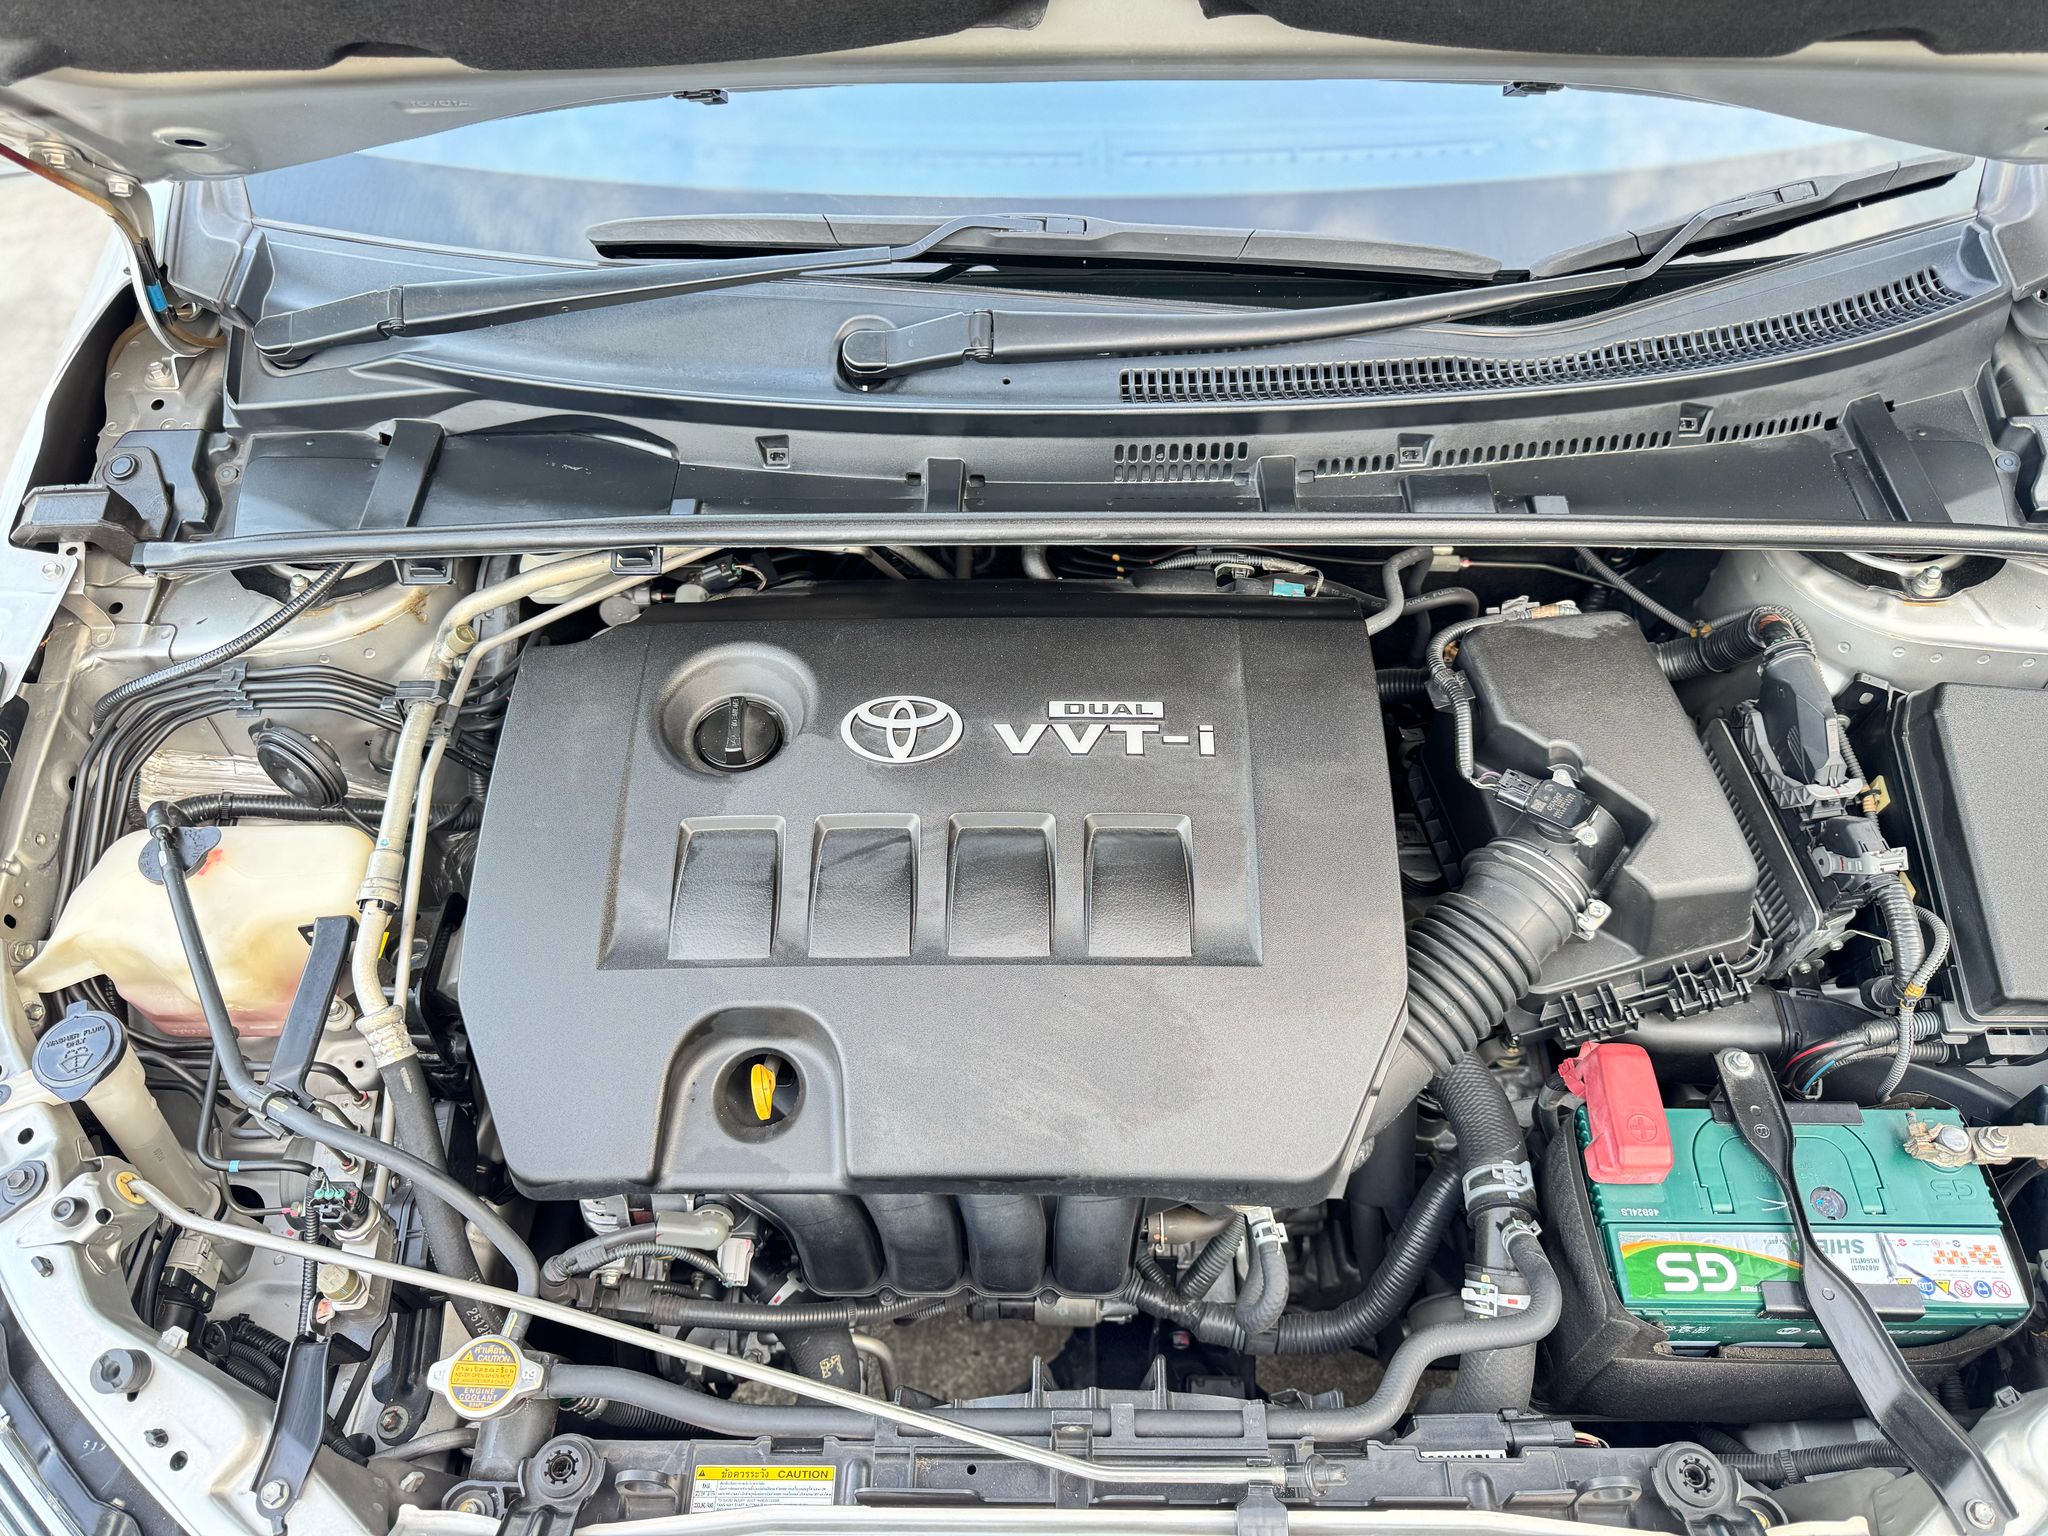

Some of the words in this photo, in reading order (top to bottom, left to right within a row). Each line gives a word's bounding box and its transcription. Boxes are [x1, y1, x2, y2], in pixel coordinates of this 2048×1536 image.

[1064, 703, 1154, 715] DUAL
[993, 723, 1216, 757] VVT-i
[66, 1037, 87, 1048] ONLY
[1656, 1252, 1738, 1292] GS
[477, 1354, 511, 1362] CAUTION
[464, 1387, 496, 1395] ENGINE
[721, 1468, 769, 1478] ข้อควรระวัง
[777, 1470, 829, 1479] CAUTION
